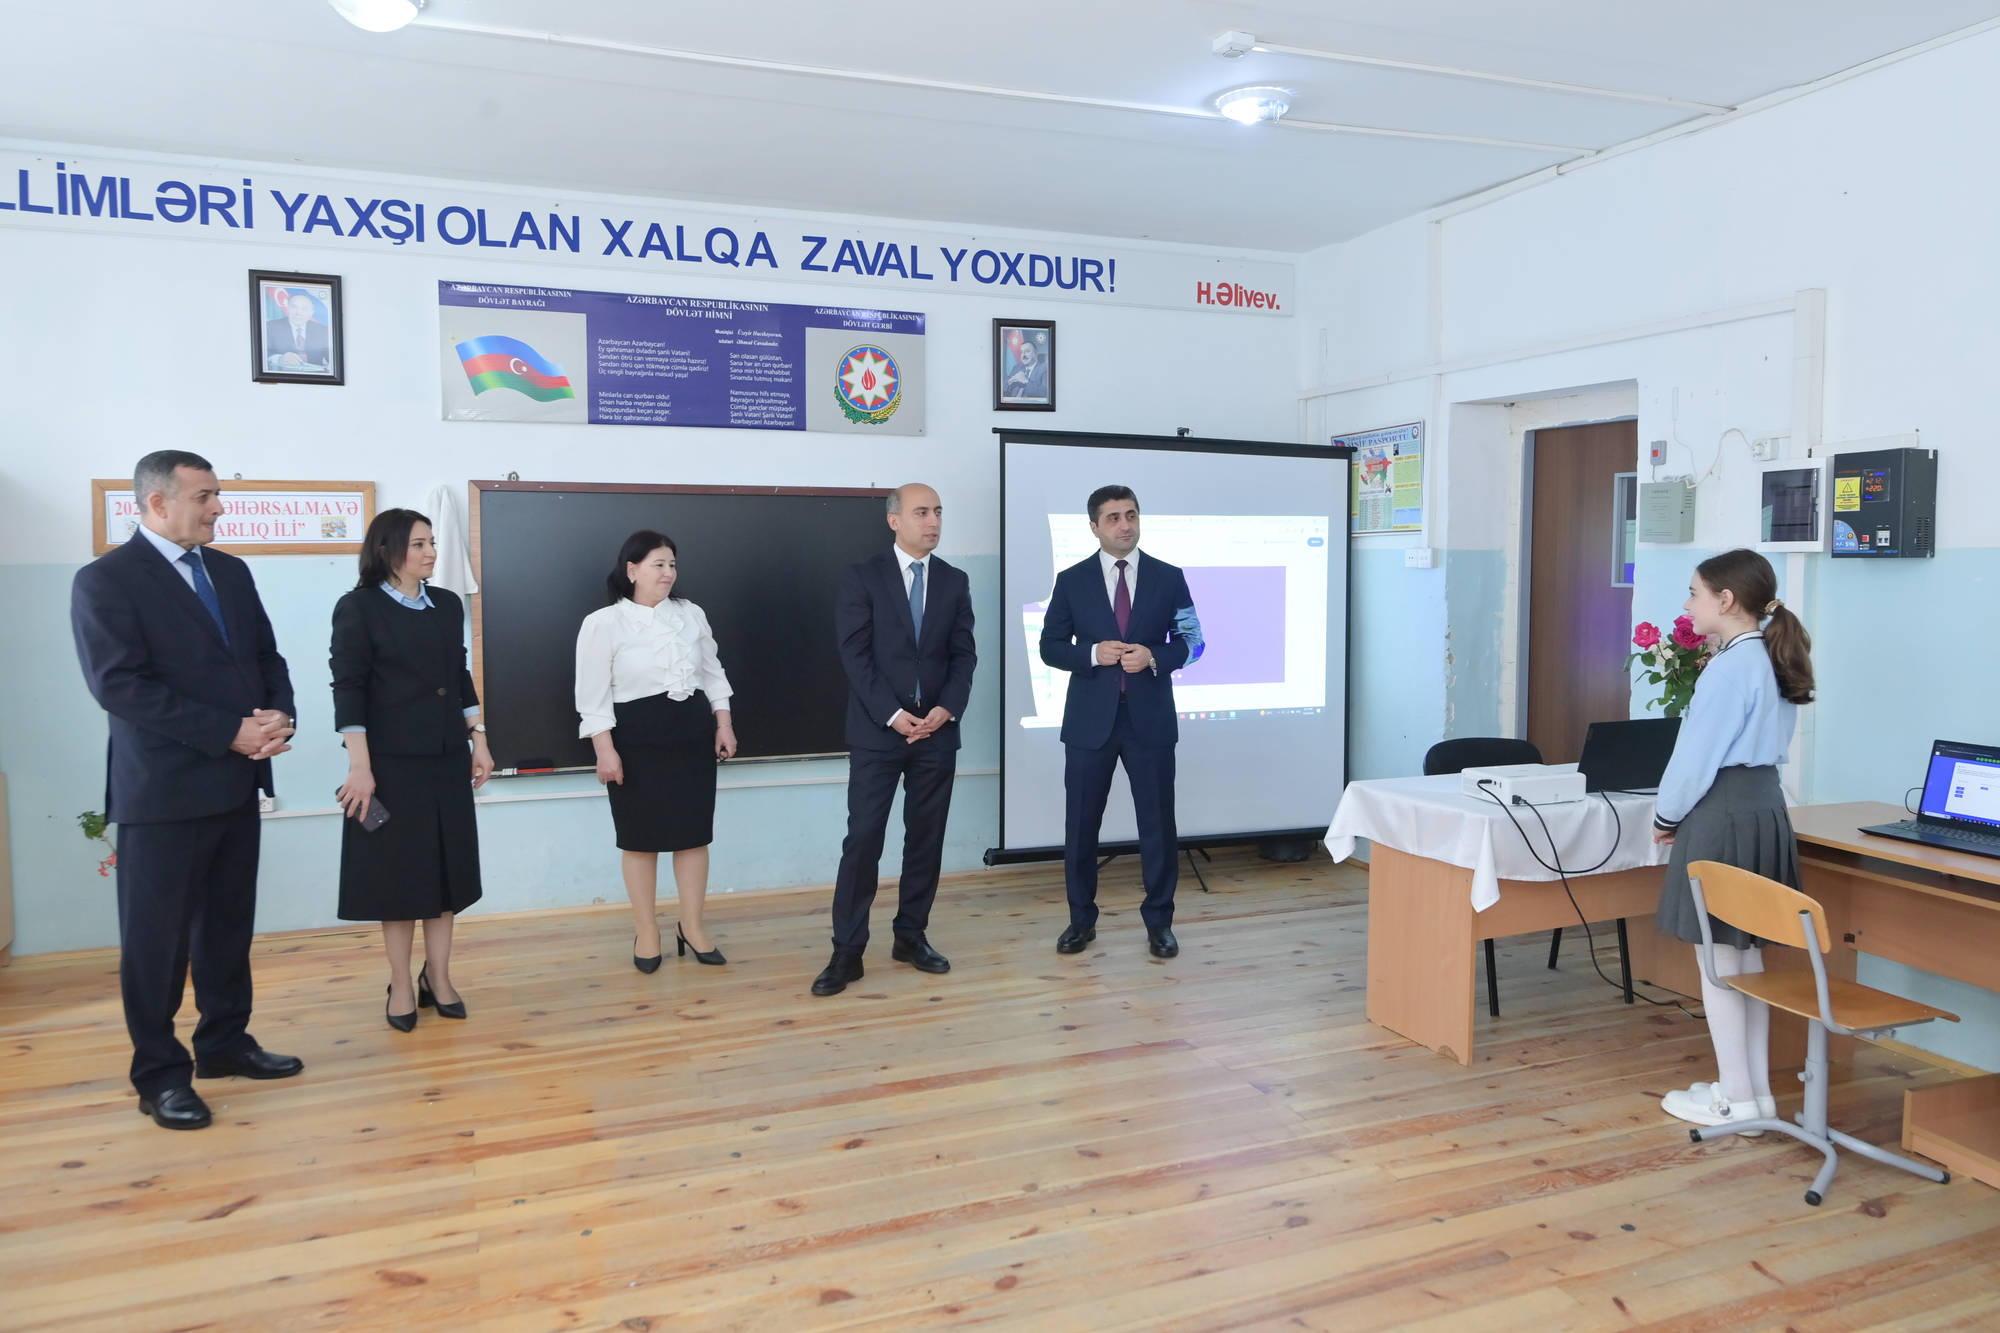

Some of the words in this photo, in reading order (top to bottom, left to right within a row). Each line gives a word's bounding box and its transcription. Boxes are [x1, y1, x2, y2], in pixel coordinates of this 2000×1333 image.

[270, 190, 425, 246] YAXŞI
[437, 205, 580, 253] OLAN
[600, 218, 779, 268] XALQA
[800, 235, 934, 281] ZAVAL
[941, 247, 1116, 292] YOXDUR!
[504, 287, 572, 298] RESPUBLİKASININ
[478, 296, 510, 306] DÖVLƏT
[512, 298, 546, 308] BAYRAĞI
[626, 296, 688, 306] AZƏRBAYCAN
[690, 300, 769, 312] RESPUBLİKASININ
[666, 307, 703, 318] DÖVLƏT
[706, 310, 733, 320] HİMNİ
[335, 501, 359, 516] VƏ
